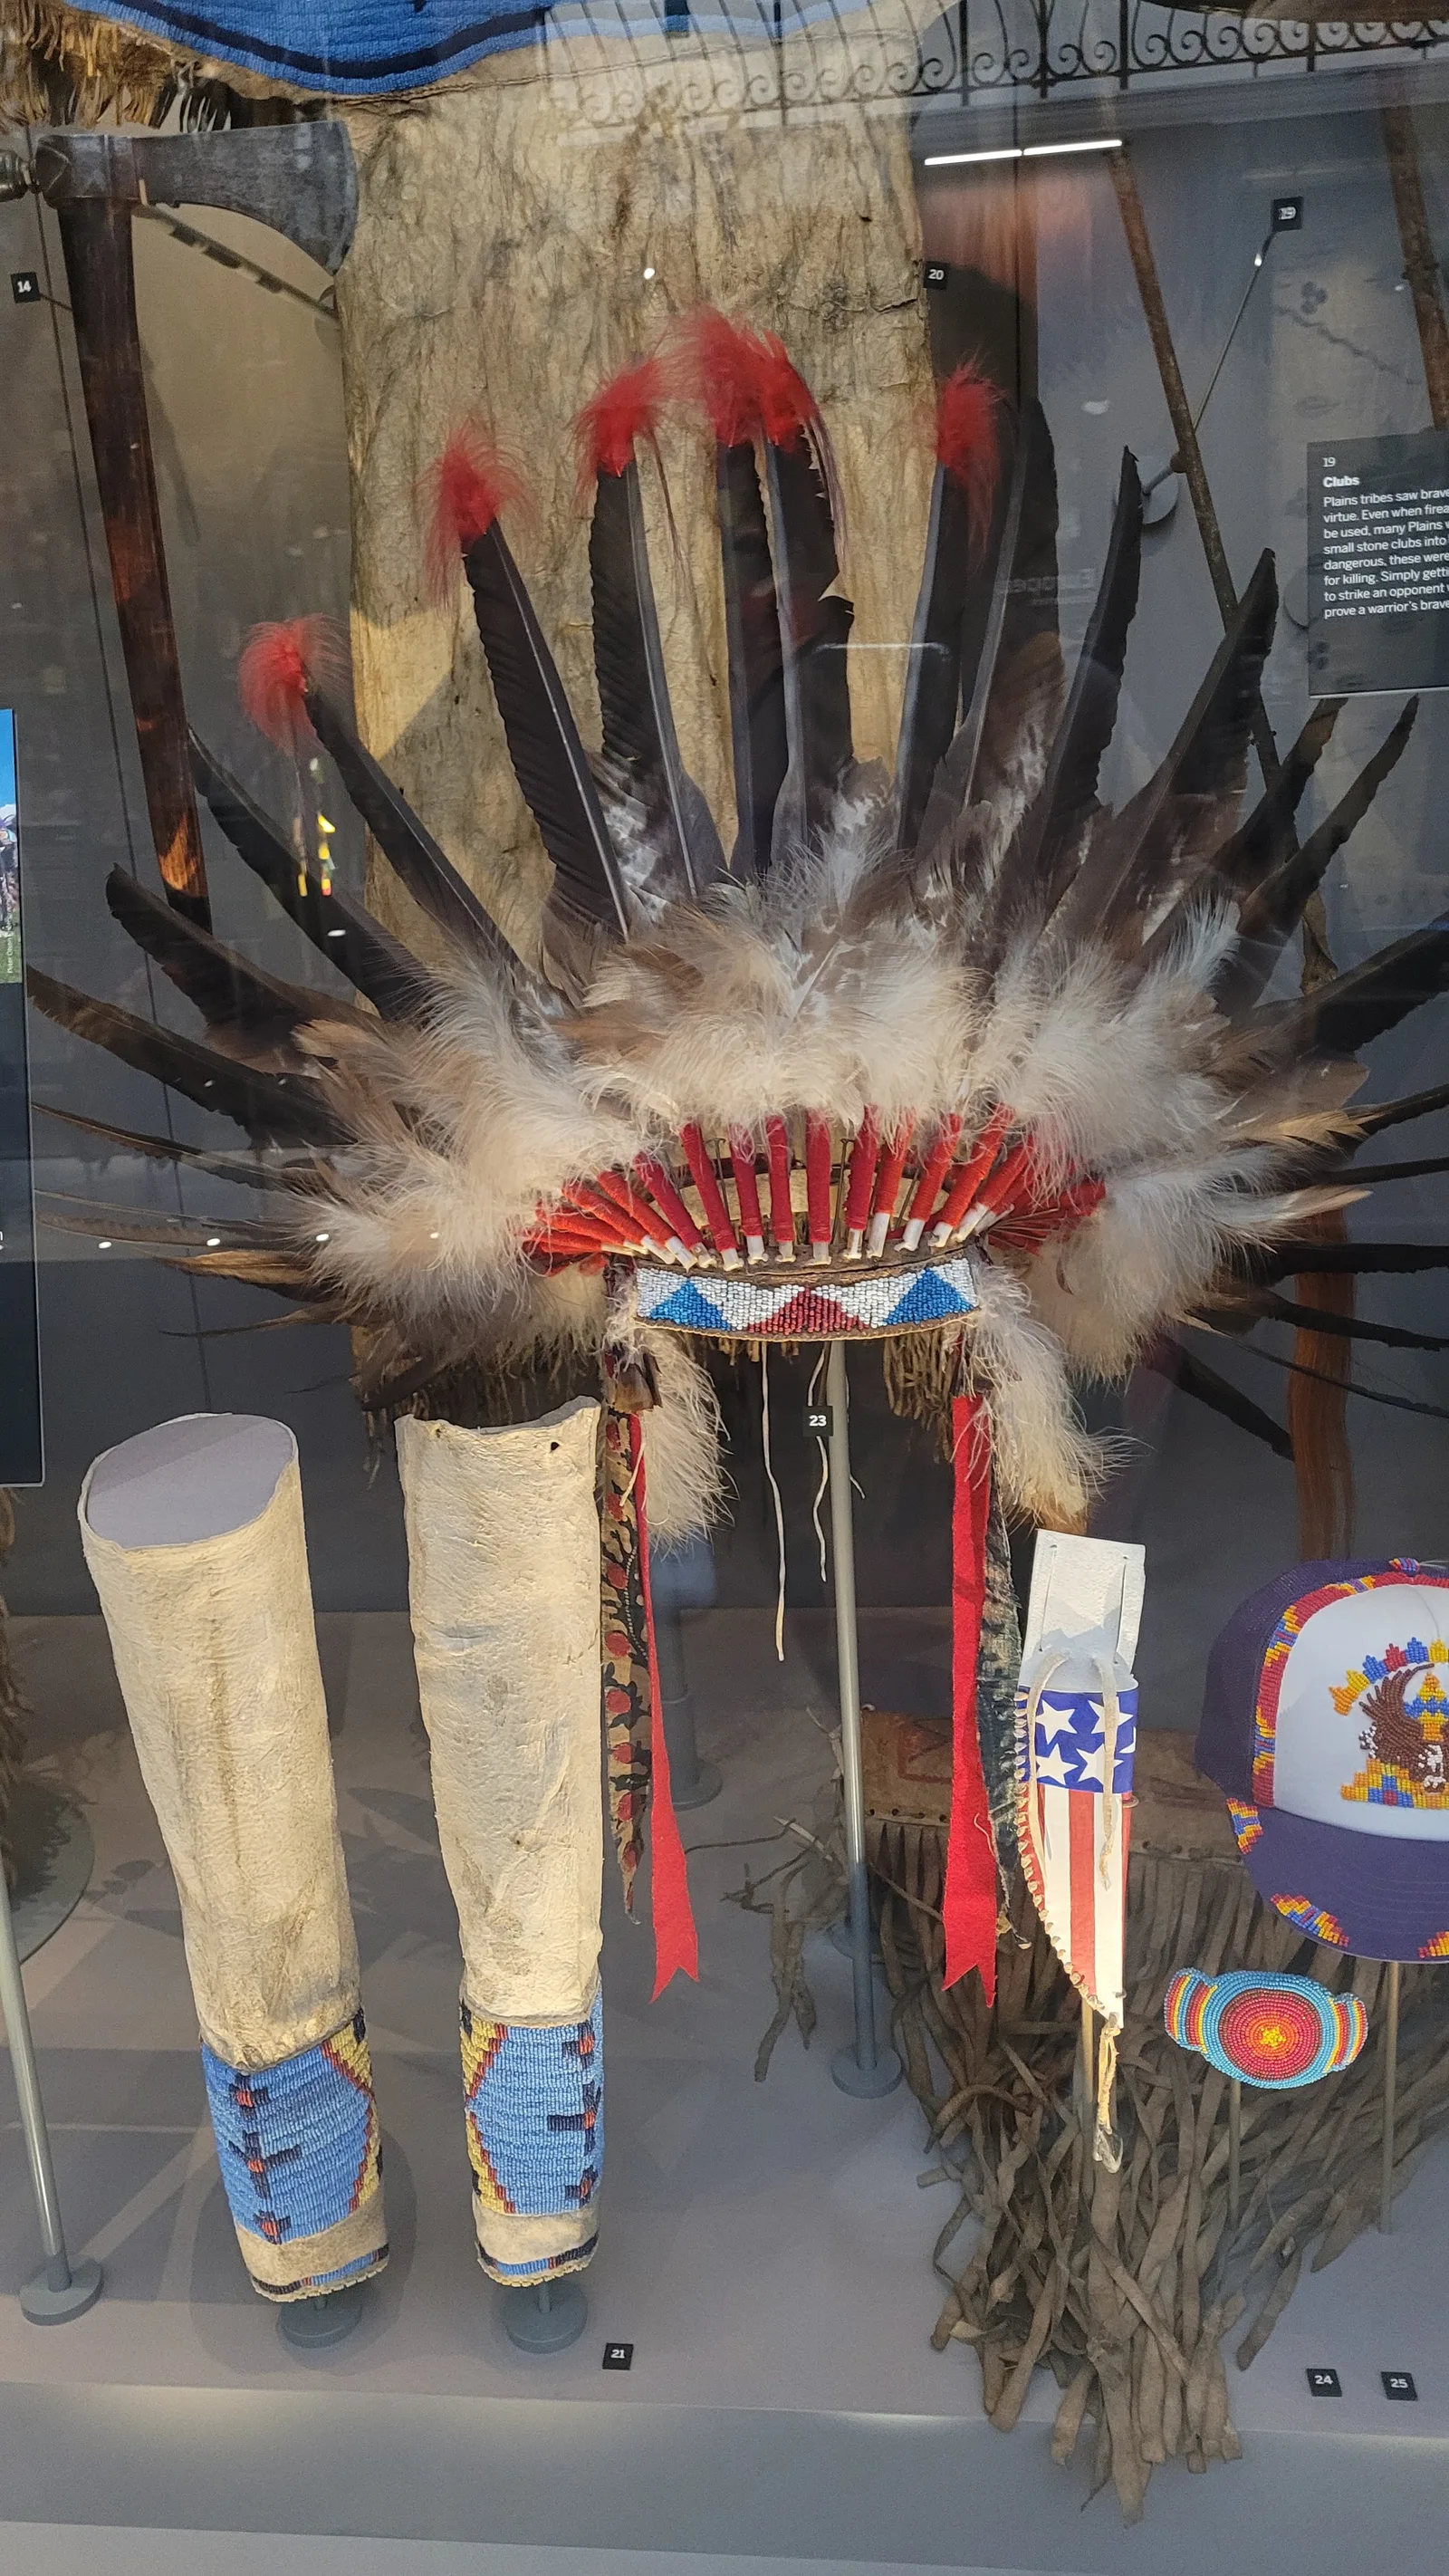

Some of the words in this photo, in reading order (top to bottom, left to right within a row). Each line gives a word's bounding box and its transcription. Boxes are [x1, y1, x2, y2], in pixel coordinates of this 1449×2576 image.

[1278, 206, 1296, 220] 19
[927, 268, 945, 280] 20
[17, 280, 32, 293] 14
[1322, 457, 1336, 467] 19
[1323, 476, 1360, 487] Clubs
[1323, 496, 1358, 507] Plains
[1360, 493, 1394, 505] tribes
[1396, 492, 1419, 502] saw
[1323, 512, 1359, 524] virtue.
[1361, 509, 1389, 521] Even
[1391, 506, 1423, 517] when
[1323, 528, 1339, 539] be
[1340, 525, 1372, 537] used,
[1373, 524, 1406, 535] many
[1407, 521, 1444, 532] Plains
[1323, 542, 1355, 554] small
[1357, 542, 1389, 553] stone
[1391, 538, 1423, 549] clubs
[1424, 535, 1447, 547] into
[1323, 557, 1387, 571] dangerous,
[1388, 554, 1422, 565] these
[1323, 575, 1340, 586] for
[1342, 572, 1378, 585] killing.
[1380, 569, 1421, 582] Simply
[1323, 591, 1337, 602] to
[1338, 589, 1370, 601] strike
[1372, 589, 1387, 598] an
[1388, 582, 1445, 598] opponent
[1324, 606, 1357, 620] prove
[1358, 606, 1366, 615] a
[1367, 601, 1419, 614] warrior's
[809, 1414, 828, 1427] 23
[610, 2349, 626, 2360] 21
[1314, 2374, 1334, 2386] 24
[1389, 2378, 1409, 2389] 25
